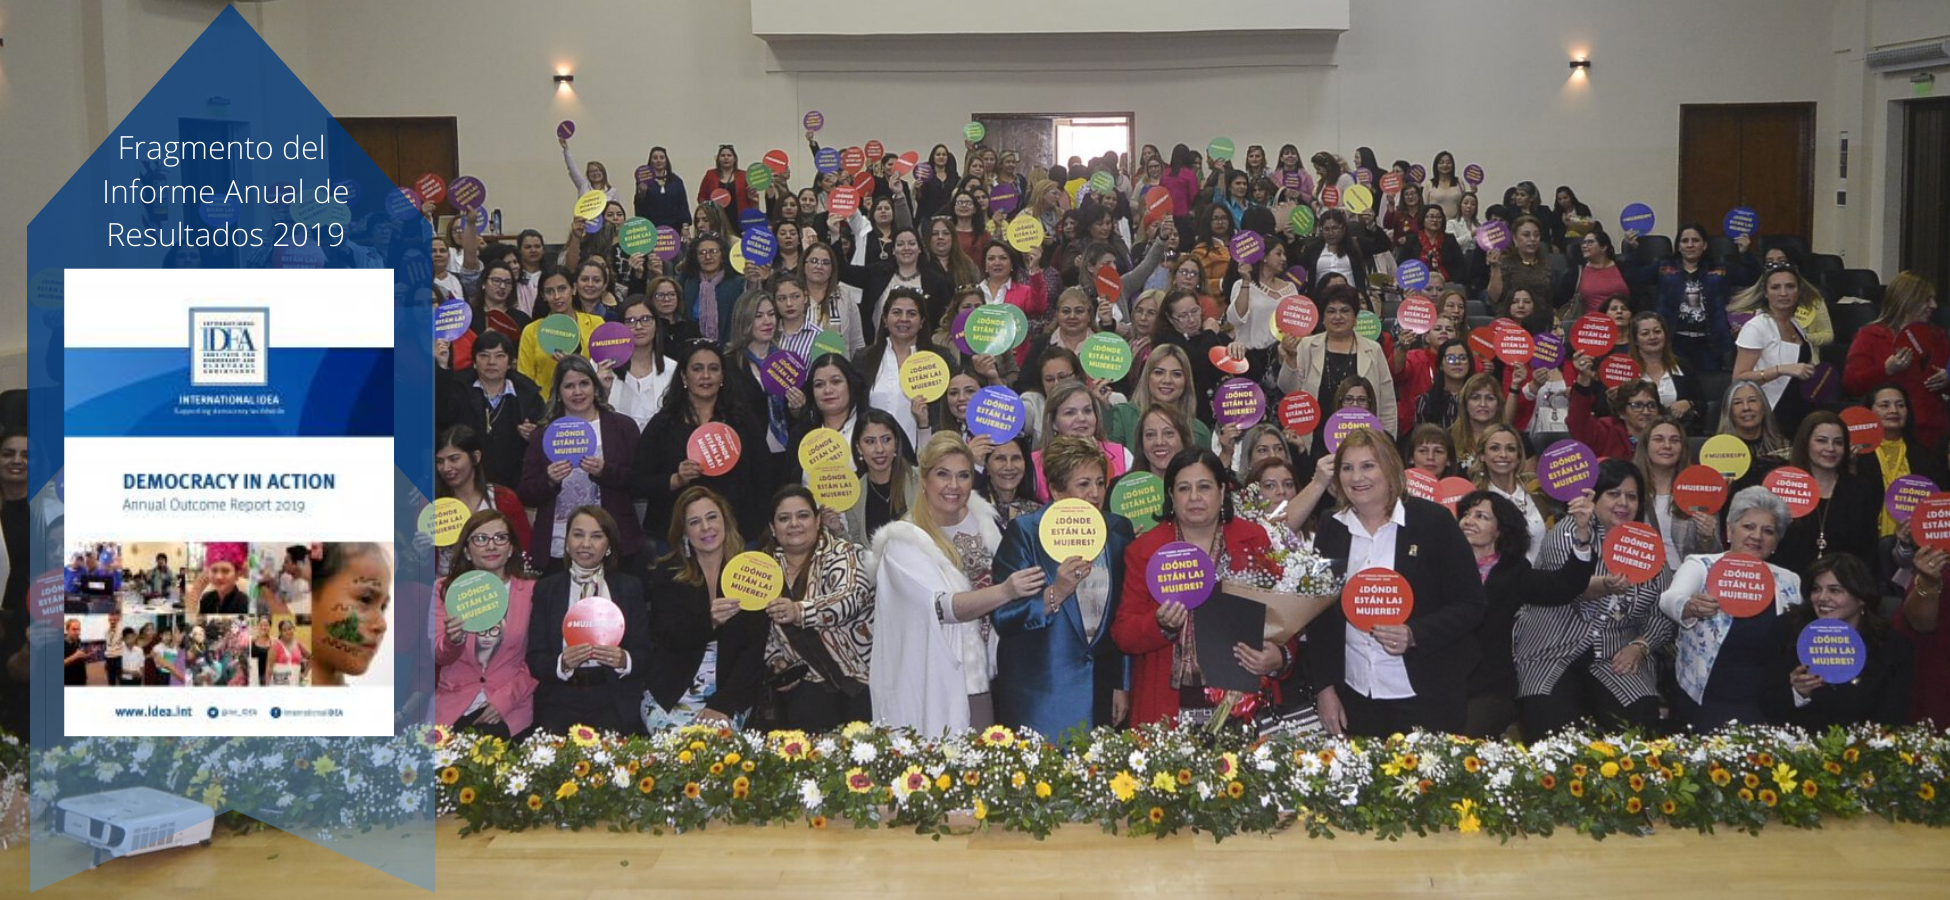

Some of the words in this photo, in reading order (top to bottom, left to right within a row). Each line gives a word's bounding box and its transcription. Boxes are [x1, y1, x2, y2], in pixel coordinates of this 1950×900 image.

[439, 309, 463, 318] ¿DÓNDE
[435, 316, 455, 325] ESTÁN
[977, 317, 1005, 327] ¿DÓNDE
[435, 322, 464, 331] MUJERES?
[973, 325, 996, 333] ESTÁN
[1583, 323, 1609, 331] ¿DÓNDE
[1578, 330, 1597, 338] ESTÁN
[591, 338, 631, 347] #MUJERESPY
[1578, 337, 1608, 346] MUJERES?
[1093, 345, 1120, 354] ¿DÓNDE
[1089, 352, 1109, 360] ESTÁN
[909, 363, 937, 374] ¿DÓNDE
[1089, 360, 1121, 370] MUJERES?
[907, 373, 929, 383] ESTÁN
[930, 370, 942, 379] LAS
[911, 379, 942, 391] MUJERES?
[1224, 391, 1253, 399] ¿DÓNDE
[983, 398, 1014, 412] ¿DÓNDE
[1222, 399, 1243, 408] ESTÁN
[976, 406, 1000, 418] ESTÁN
[1002, 413, 1016, 423] LAS
[1223, 407, 1256, 416] MUJERES?
[975, 416, 1012, 431] MUJERES?
[1848, 422, 1878, 432] UJERESPY
[556, 429, 585, 438] ¿DÓNDE
[552, 438, 575, 447] ESTÁN
[713, 432, 730, 461] ¿DÓNDE
[808, 437, 833, 456] ¿DÓNDE
[554, 447, 588, 455] MUJERES?
[697, 438, 715, 469] MUJERES?
[704, 433, 718, 454] ESTÁN
[714, 453, 724, 467] LAS
[809, 450, 829, 465] ESTÁN
[829, 443, 841, 452] LAS
[1549, 452, 1582, 469] ¿DÓNDE
[1548, 466, 1573, 480] ESTÁN
[1574, 461, 1589, 471] LAS
[818, 474, 846, 482] ¿DÓNDE
[1553, 471, 1589, 489] MUJERES?
[817, 481, 838, 490] ESTÁN
[1676, 484, 1722, 493] #MUJERESPY
[1776, 480, 1808, 488] ¿DÓNDE
[820, 490, 852, 499] MUJERES?
[1123, 486, 1154, 500] ¿DÓNDE
[1121, 498, 1146, 510] ESTÁN
[1147, 494, 1162, 503] LAS
[430, 509, 457, 520] ¿DÓNDE
[427, 518, 449, 529] ESTÁN
[1055, 516, 1092, 525] ¿DÓNDE
[430, 523, 462, 535] MUJERES?
[1051, 527, 1078, 536] ESTÁN
[1081, 528, 1096, 536] LAS
[1621, 535, 1654, 551] ¿DÓNDE
[1613, 543, 1639, 557] ESTÁN
[1640, 552, 1656, 562] LAS
[1161, 560, 1198, 571] ¿DÓNDE
[1612, 553, 1652, 570] MUJERES?
[741, 565, 773, 580] ¿DÓNDE
[1157, 571, 1186, 583] ESTÁN
[1188, 570, 1204, 579] LAS
[1723, 569, 1761, 580] ¿DÓNDE
[733, 572, 757, 585] ESTÁN
[758, 581, 772, 590] LAS
[1718, 579, 1746, 589] ESTÁN
[1748, 583, 1764, 591] LAS
[457, 583, 491, 601] ¿DÓNDE
[731, 582, 767, 599] MUJERES?
[1161, 581, 1203, 594] MUJERES?
[1359, 585, 1398, 594] ¿DÓNDE
[1354, 595, 1383, 604] ESTÁN
[1386, 597, 1402, 605] LAS
[1719, 590, 1762, 601] MUJERES?
[456, 597, 482, 612] ESTÁN
[483, 591, 497, 602] LAS
[462, 601, 499, 620] MUJERES?
[1356, 607, 1400, 616] MUJERES?
[1813, 635, 1850, 644] ¿DÓNDE
[1809, 645, 1837, 654] ESTÁN
[1812, 657, 1855, 666] MUJERES?
